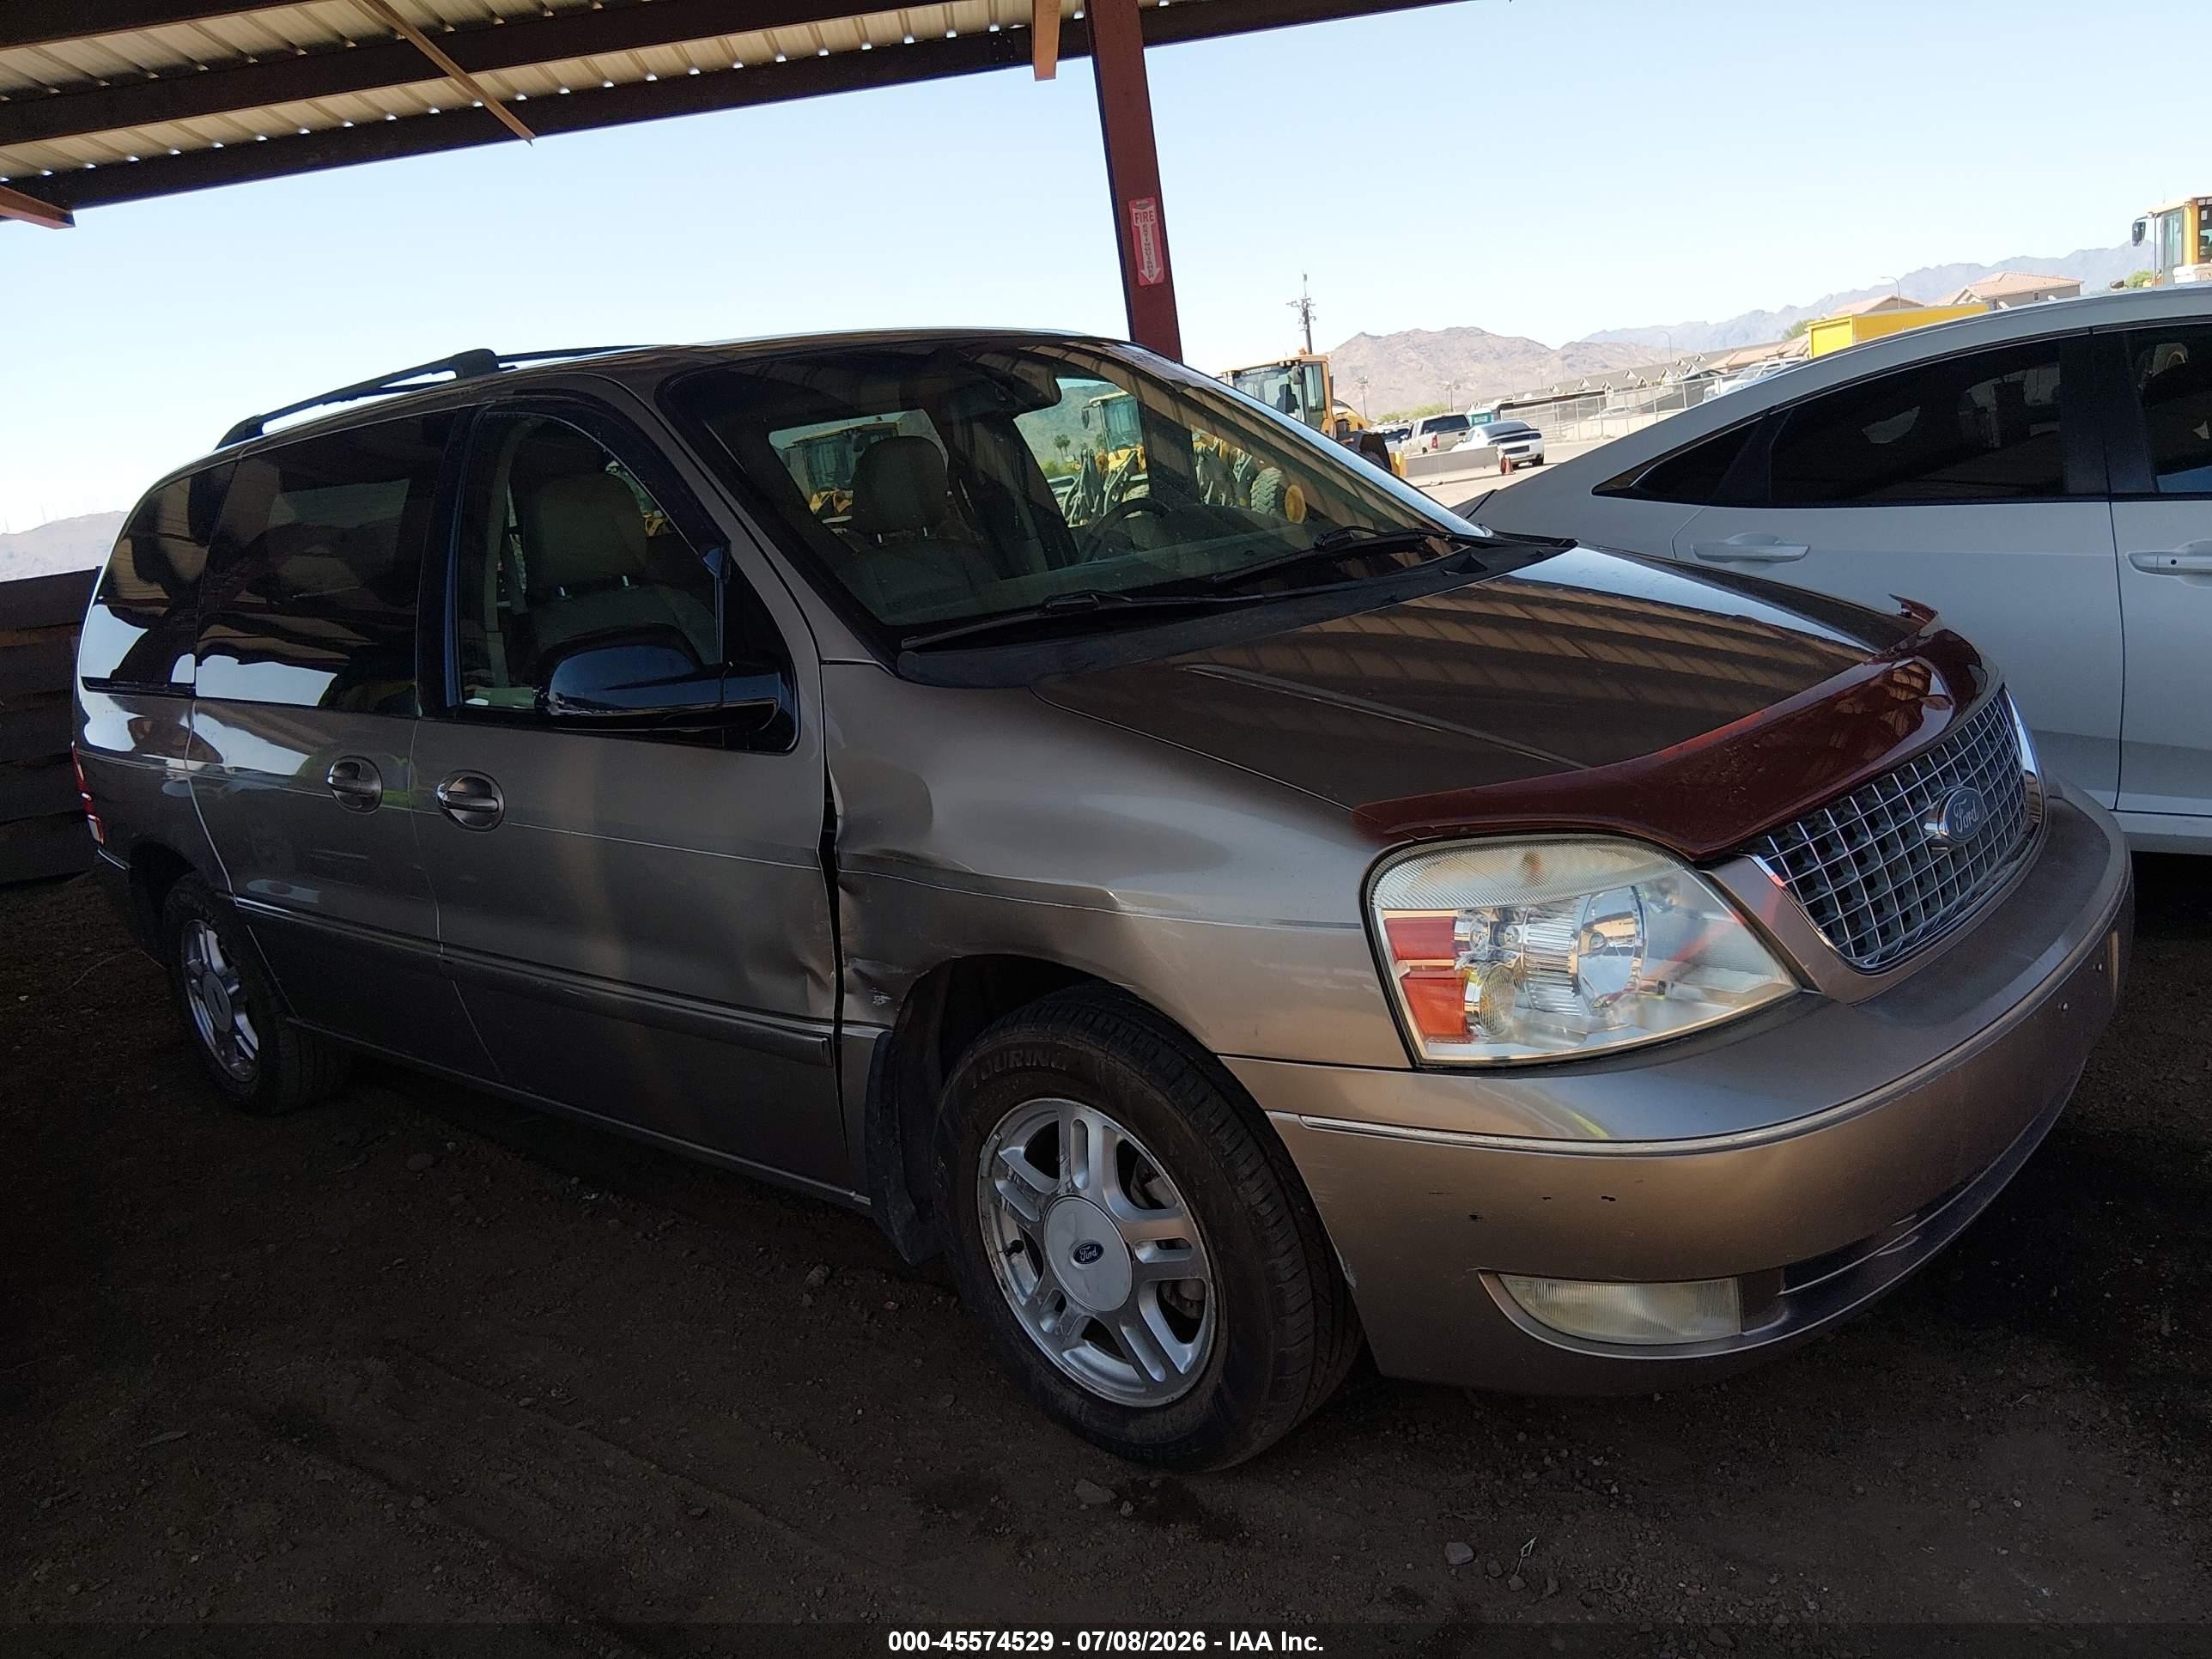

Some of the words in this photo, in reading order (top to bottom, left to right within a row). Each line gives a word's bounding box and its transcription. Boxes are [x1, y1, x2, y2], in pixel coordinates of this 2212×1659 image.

[1134, 210, 1154, 224] FIRE
[1954, 798, 1978, 833] Ford
[973, 1049, 1068, 1088] OURING
[1079, 1245, 1098, 1261] Ford
